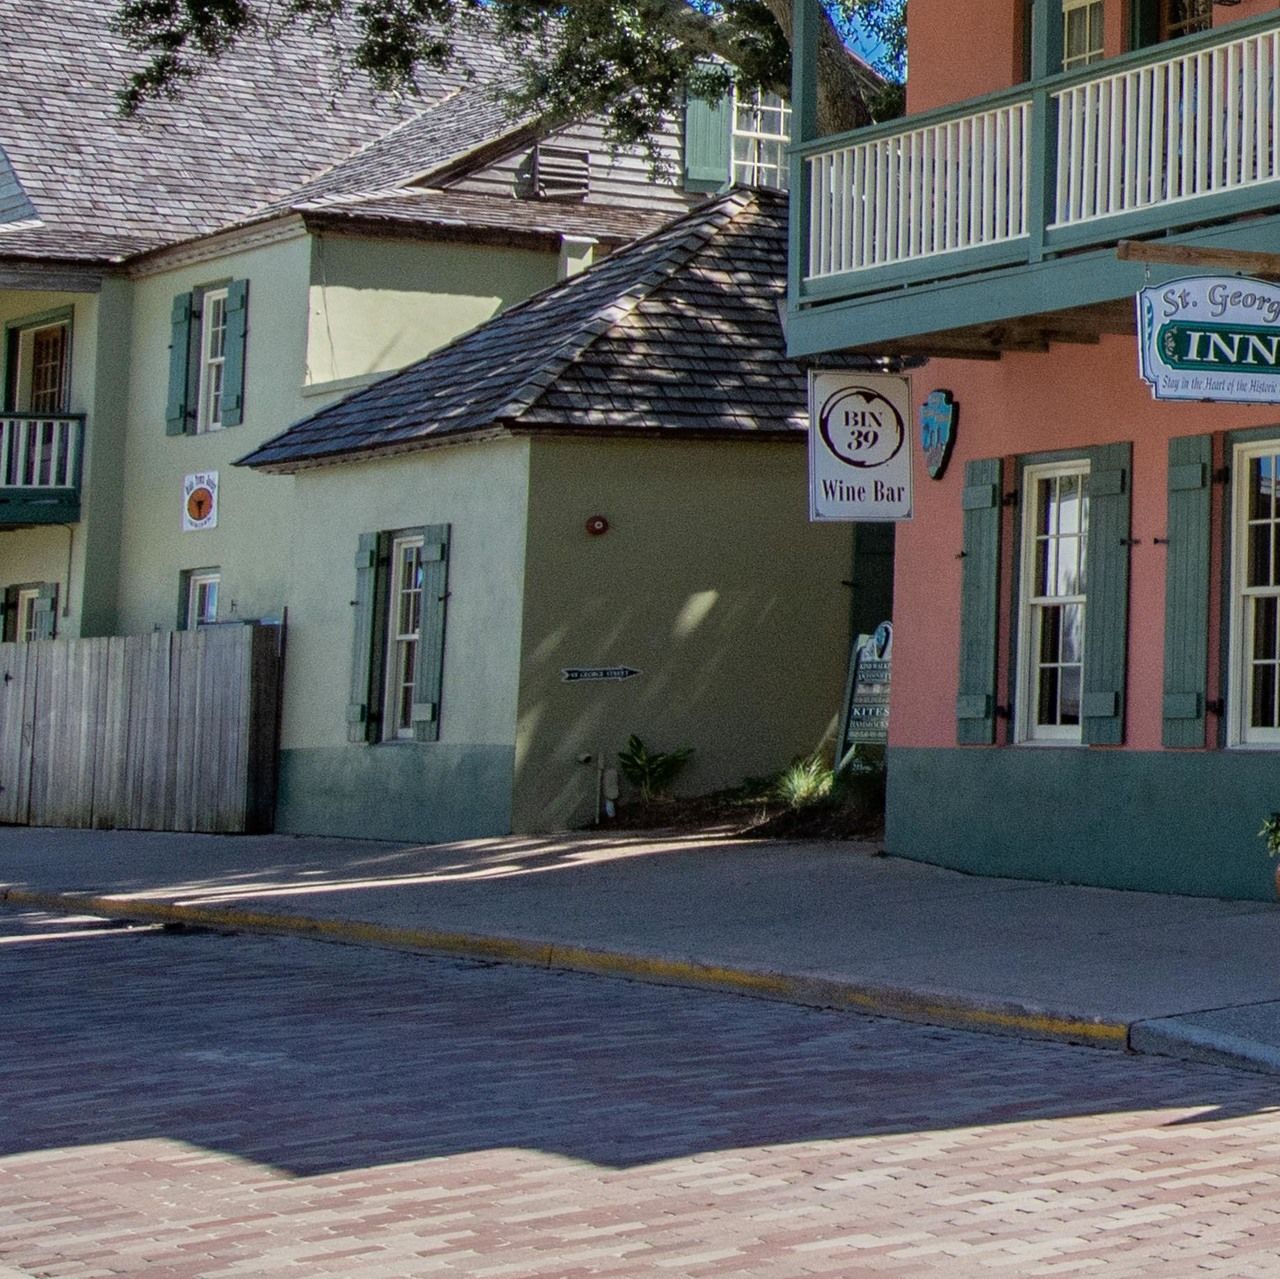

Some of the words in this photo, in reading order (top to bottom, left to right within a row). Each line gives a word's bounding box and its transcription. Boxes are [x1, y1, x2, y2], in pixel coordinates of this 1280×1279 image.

[1163, 288, 1198, 317] St.
[1162, 375, 1179, 392] Stay
[1181, 377, 1190, 389] in
[1191, 377, 1202, 390] the
[1203, 377, 1225, 391] Heart
[1227, 378, 1235, 395] of
[1236, 379, 1247, 392] the
[1248, 380, 1277, 393] Historic
[844, 411, 883, 428] BIN
[847, 430, 880, 450] 39
[822, 479, 866, 503] Wine
[873, 480, 905, 503] Bar
